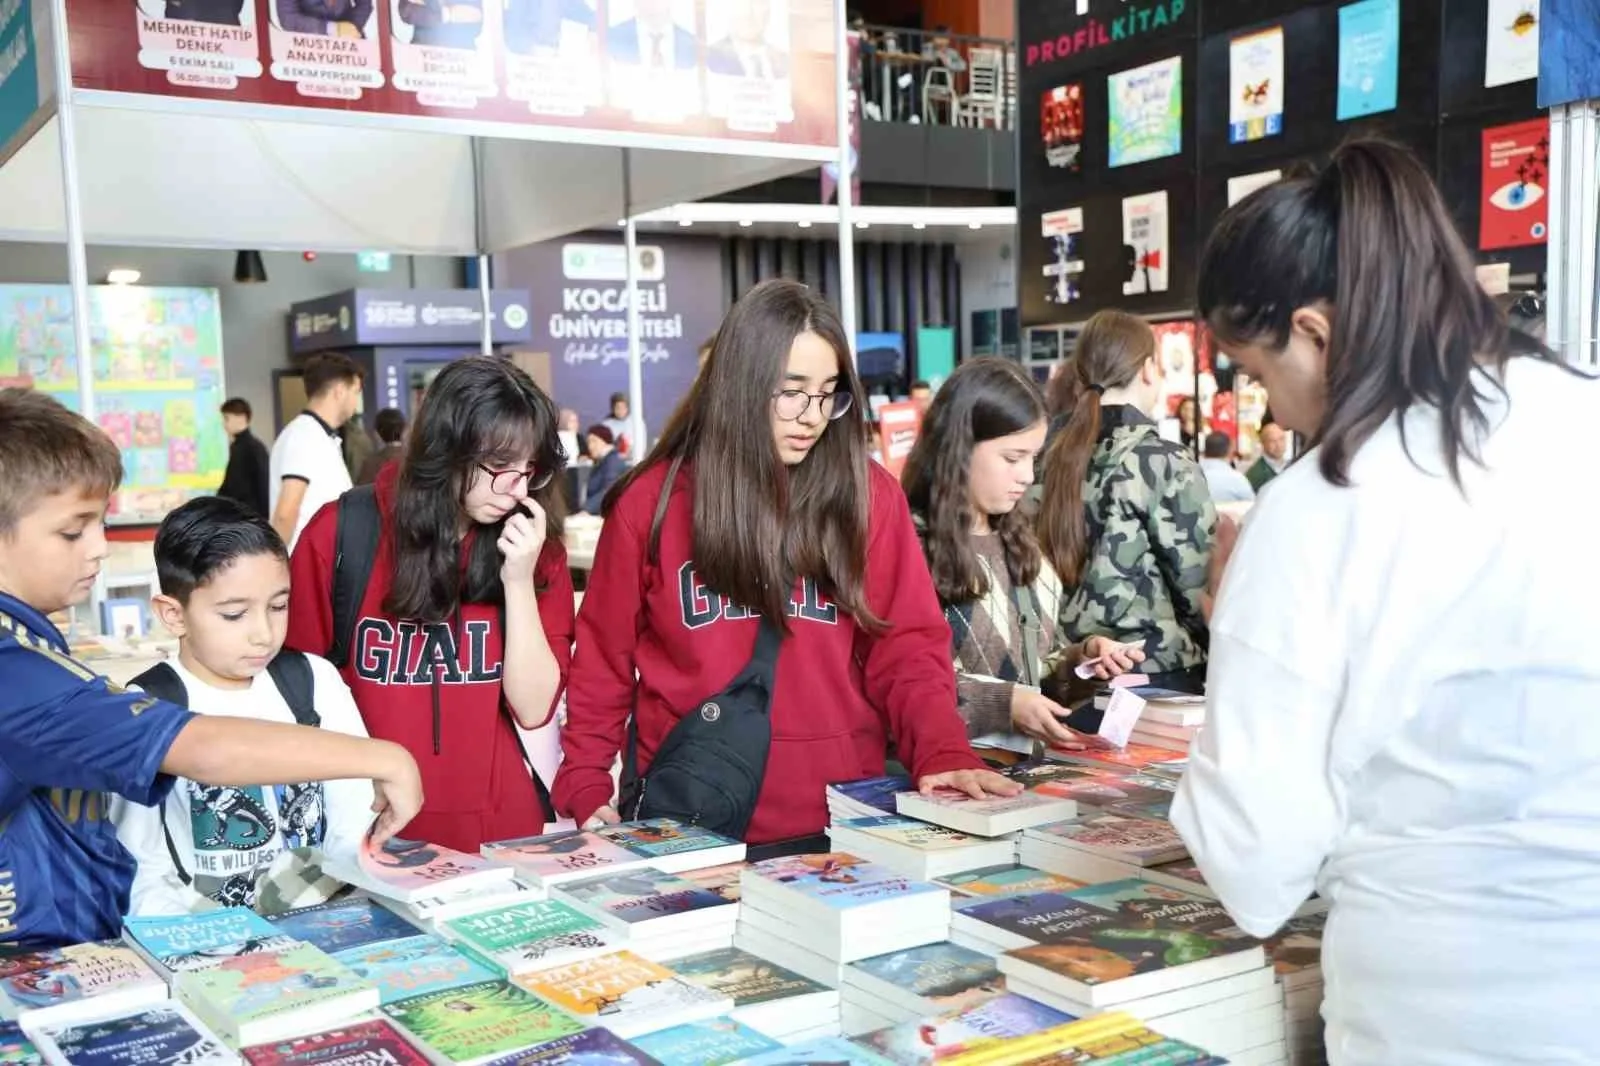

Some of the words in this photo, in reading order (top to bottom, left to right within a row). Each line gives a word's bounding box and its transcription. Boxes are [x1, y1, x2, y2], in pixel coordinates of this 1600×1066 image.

[143, 20, 206, 38] MEHMET
[210, 28, 253, 42] HATİP
[176, 38, 224, 54] DENEK
[293, 37, 358, 53] MUSTAFA
[287, 50, 367, 66] ANAYURTLU
[549, 313, 683, 339] ÜNİVERİTESİ
[678, 560, 838, 630] GL
[354, 617, 503, 686] GIAL
[194, 853, 217, 871] THE
[222, 848, 282, 871] WILDES
